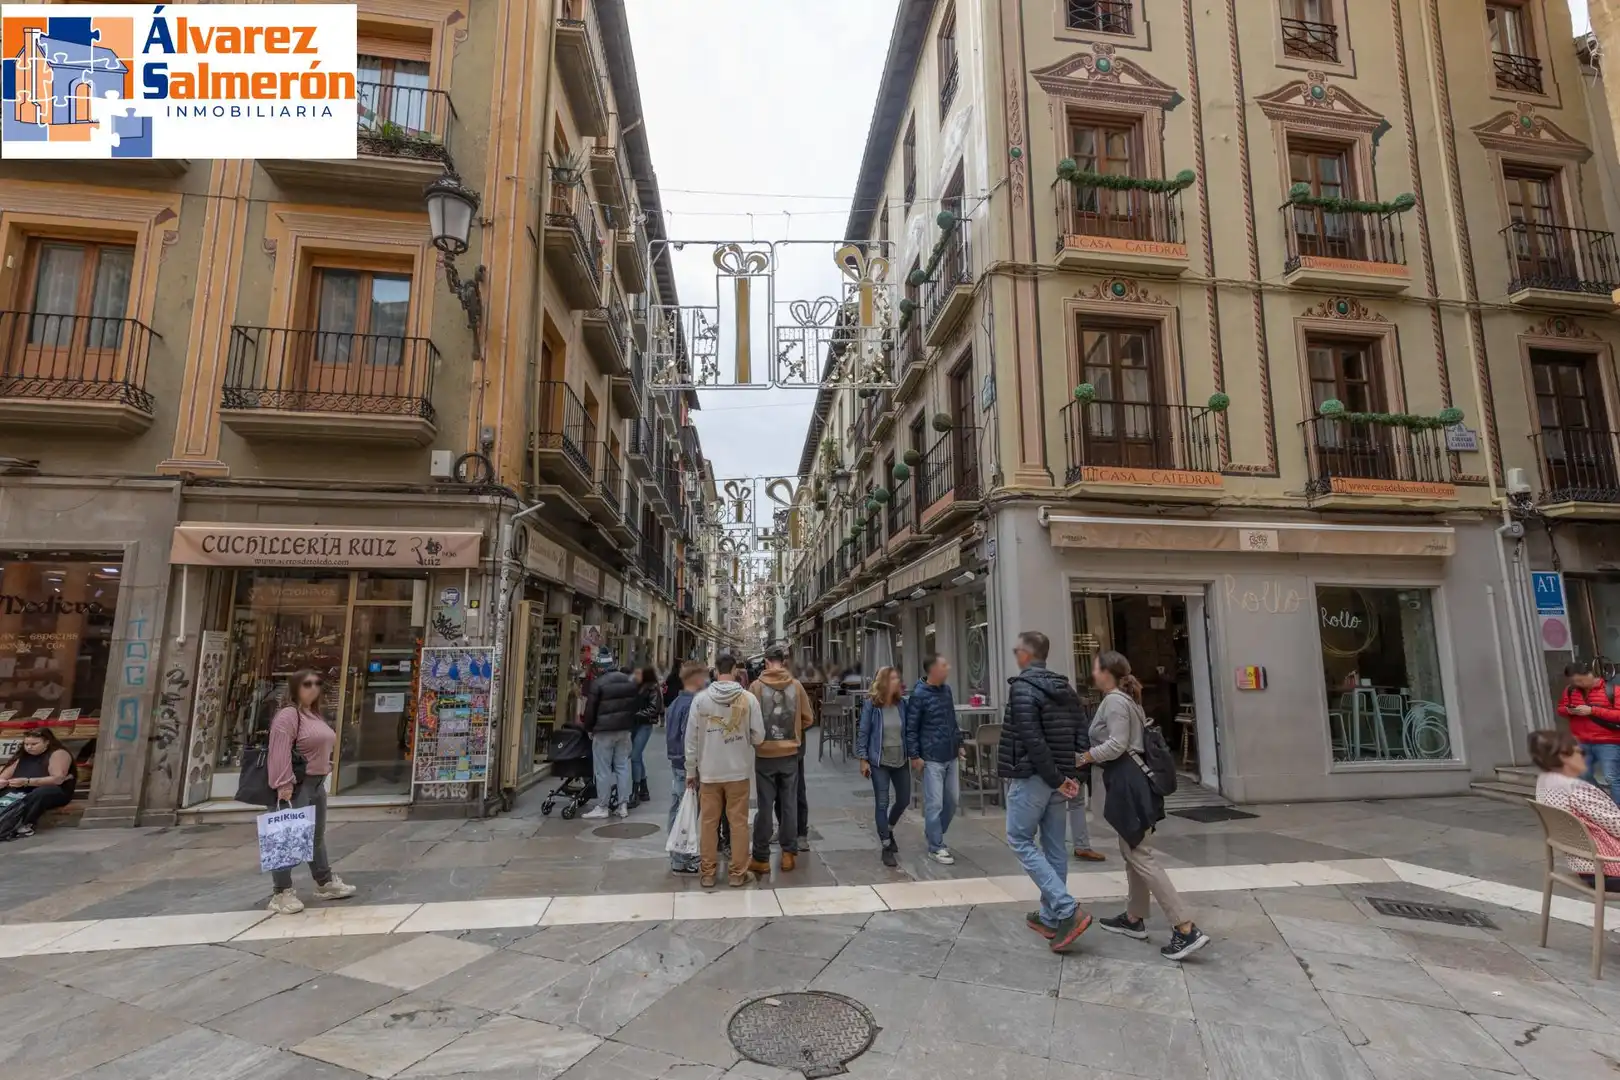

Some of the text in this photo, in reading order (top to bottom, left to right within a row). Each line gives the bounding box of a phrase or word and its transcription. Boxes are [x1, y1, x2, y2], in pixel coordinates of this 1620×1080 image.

[1080, 238, 1112, 249] CASA
[1099, 470, 1137, 481] CASA
[202, 533, 397, 557] CUCHILLERÍA RUIZ
[1537, 575, 1556, 593] AT
[1320, 606, 1362, 629] Rollo
[268, 811, 306, 825] FRIKING
